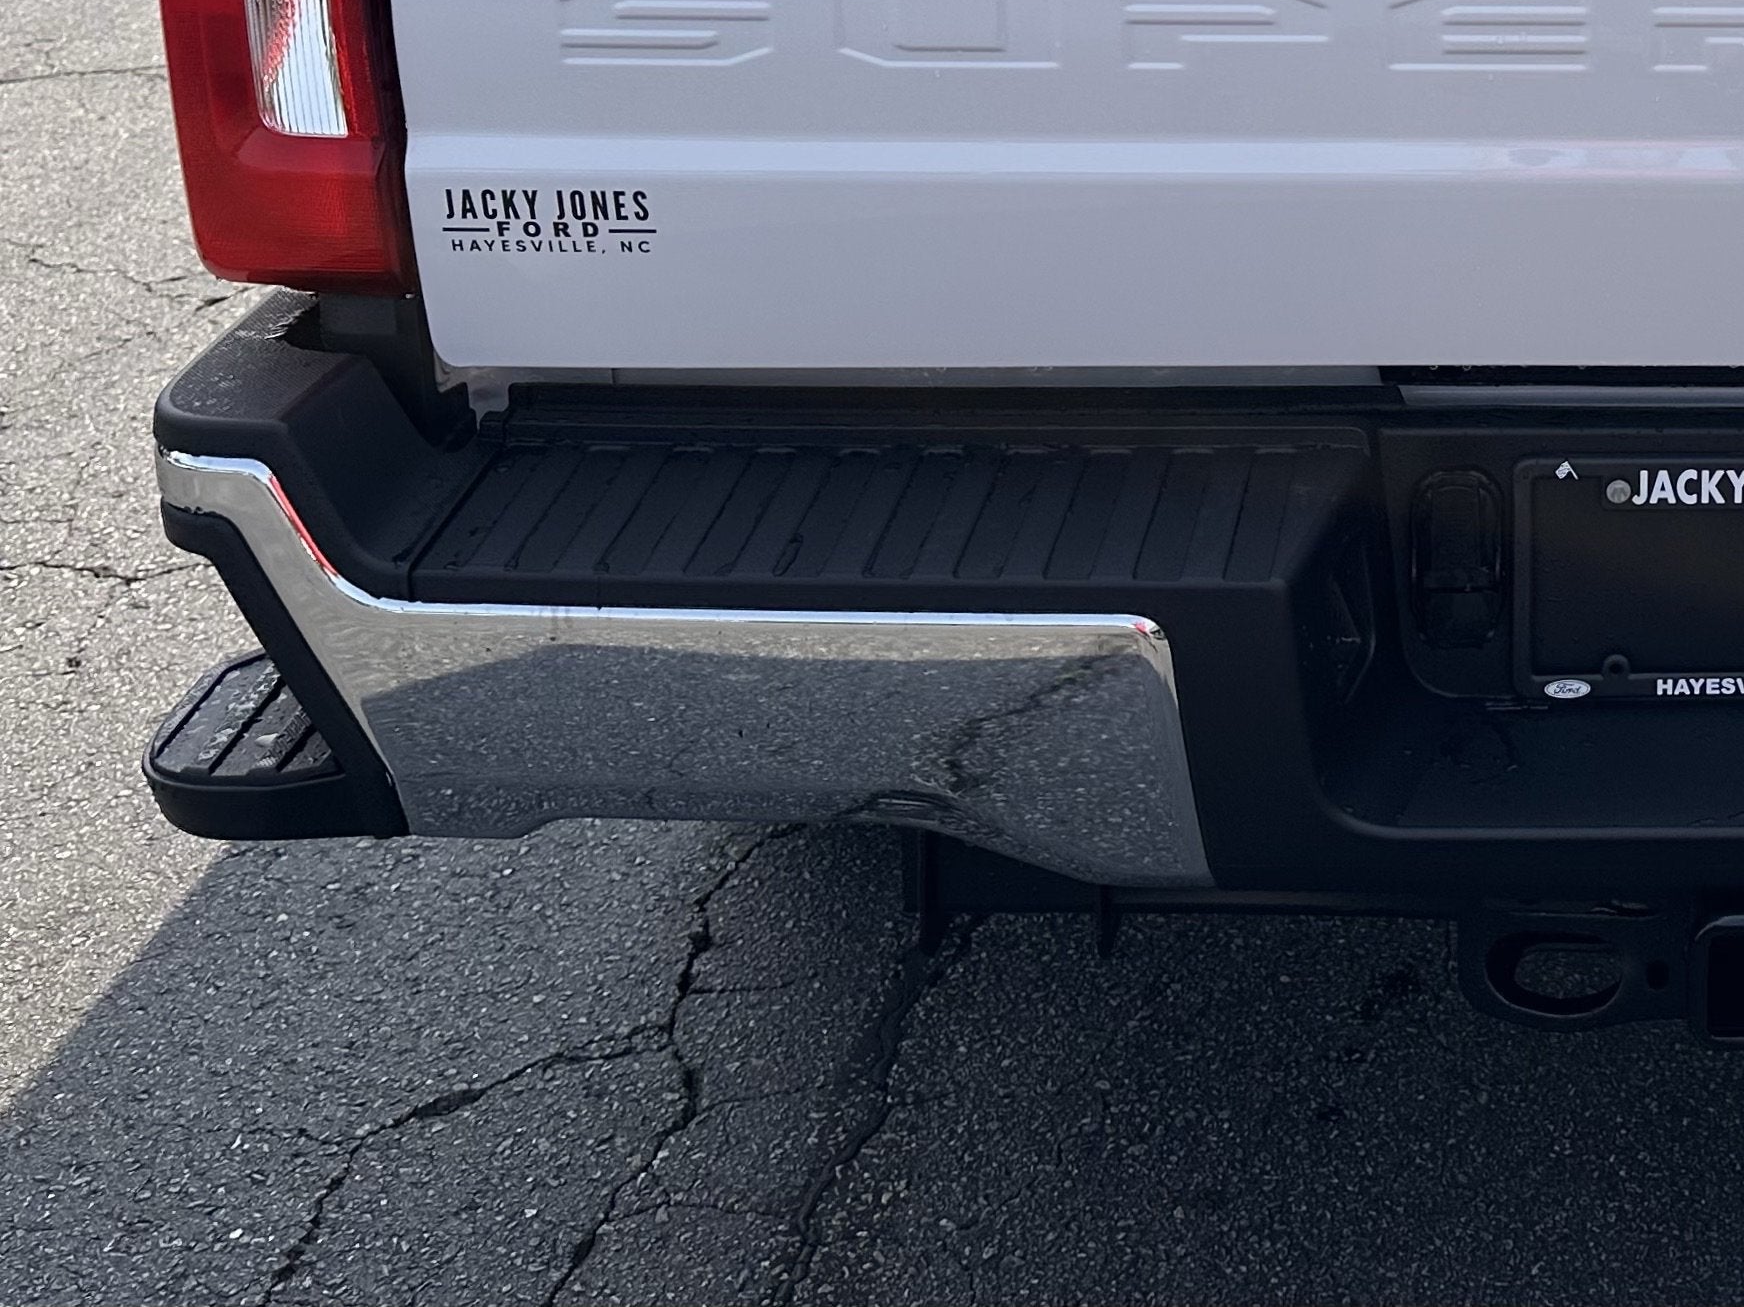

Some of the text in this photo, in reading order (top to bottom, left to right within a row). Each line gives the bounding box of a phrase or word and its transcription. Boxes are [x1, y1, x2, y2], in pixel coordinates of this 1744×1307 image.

[445, 188, 650, 221] JACKY JONES
[496, 221, 600, 238] FORD
[451, 239, 652, 254] HAYESVILLE, NC
